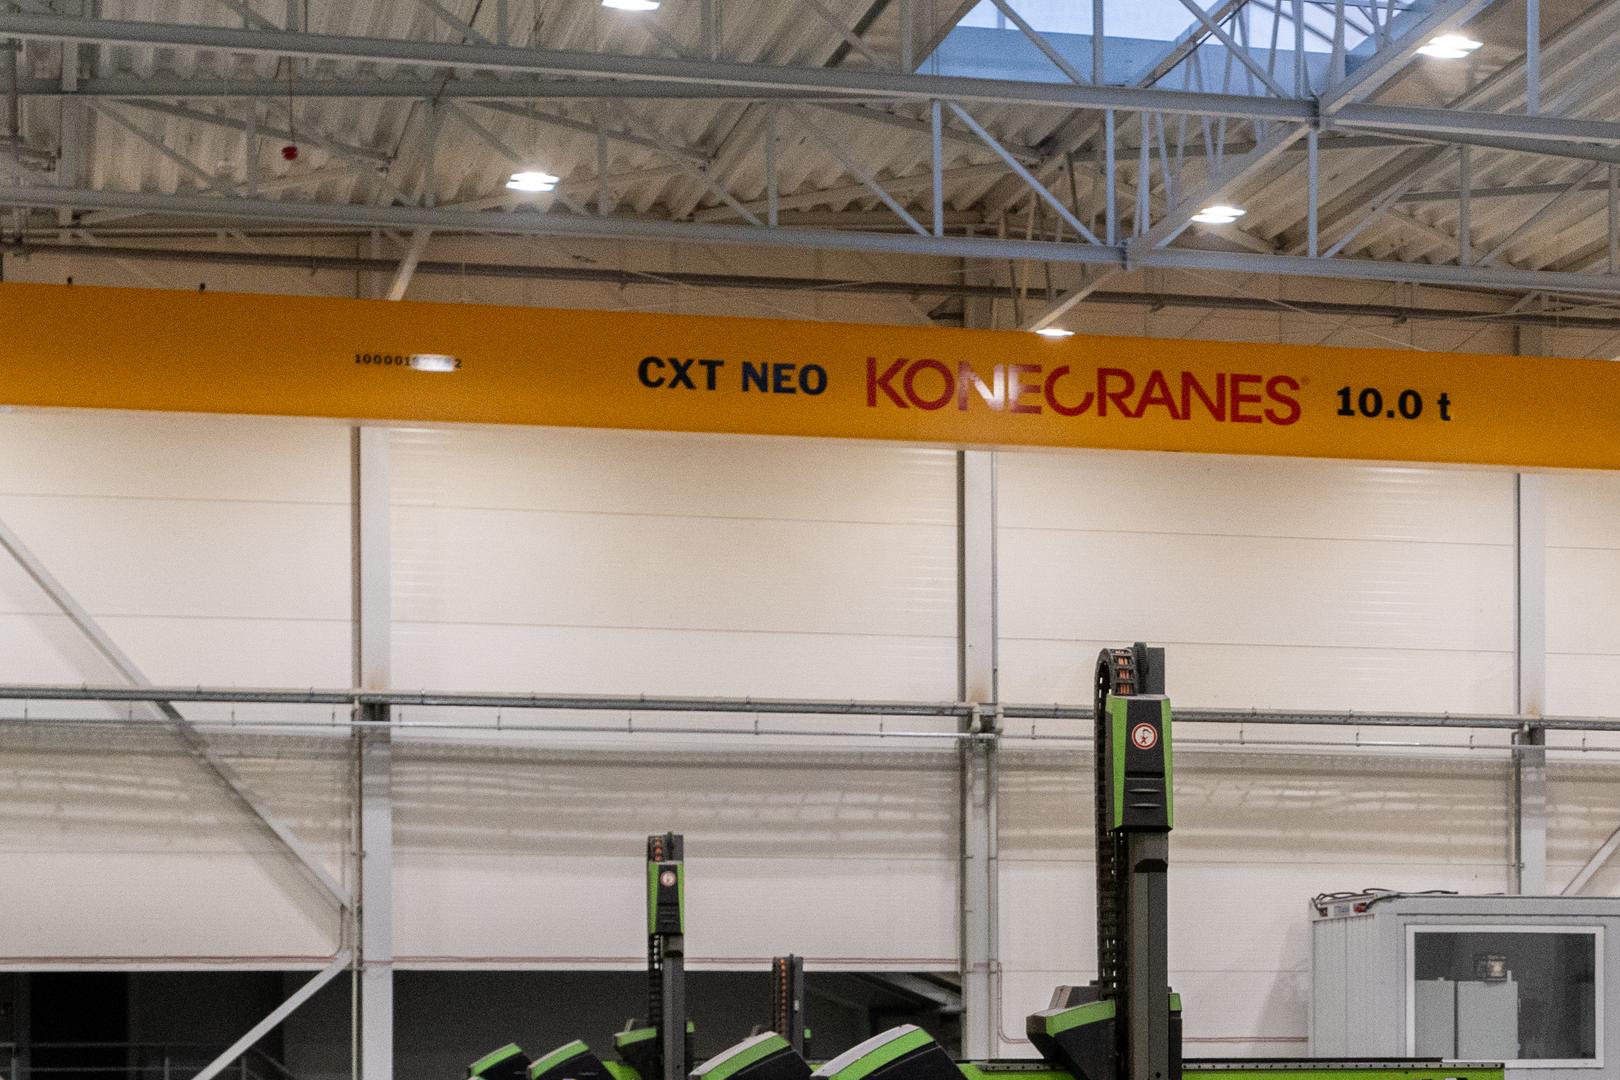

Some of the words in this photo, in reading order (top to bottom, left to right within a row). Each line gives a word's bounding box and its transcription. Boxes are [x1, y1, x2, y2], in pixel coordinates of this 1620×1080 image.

[638, 356, 725, 391] CXT
[741, 361, 828, 396] NEO
[866, 357, 1302, 426] KONECRANES
[1337, 386, 1423, 420] 10.0
[1437, 392, 1451, 421] t
